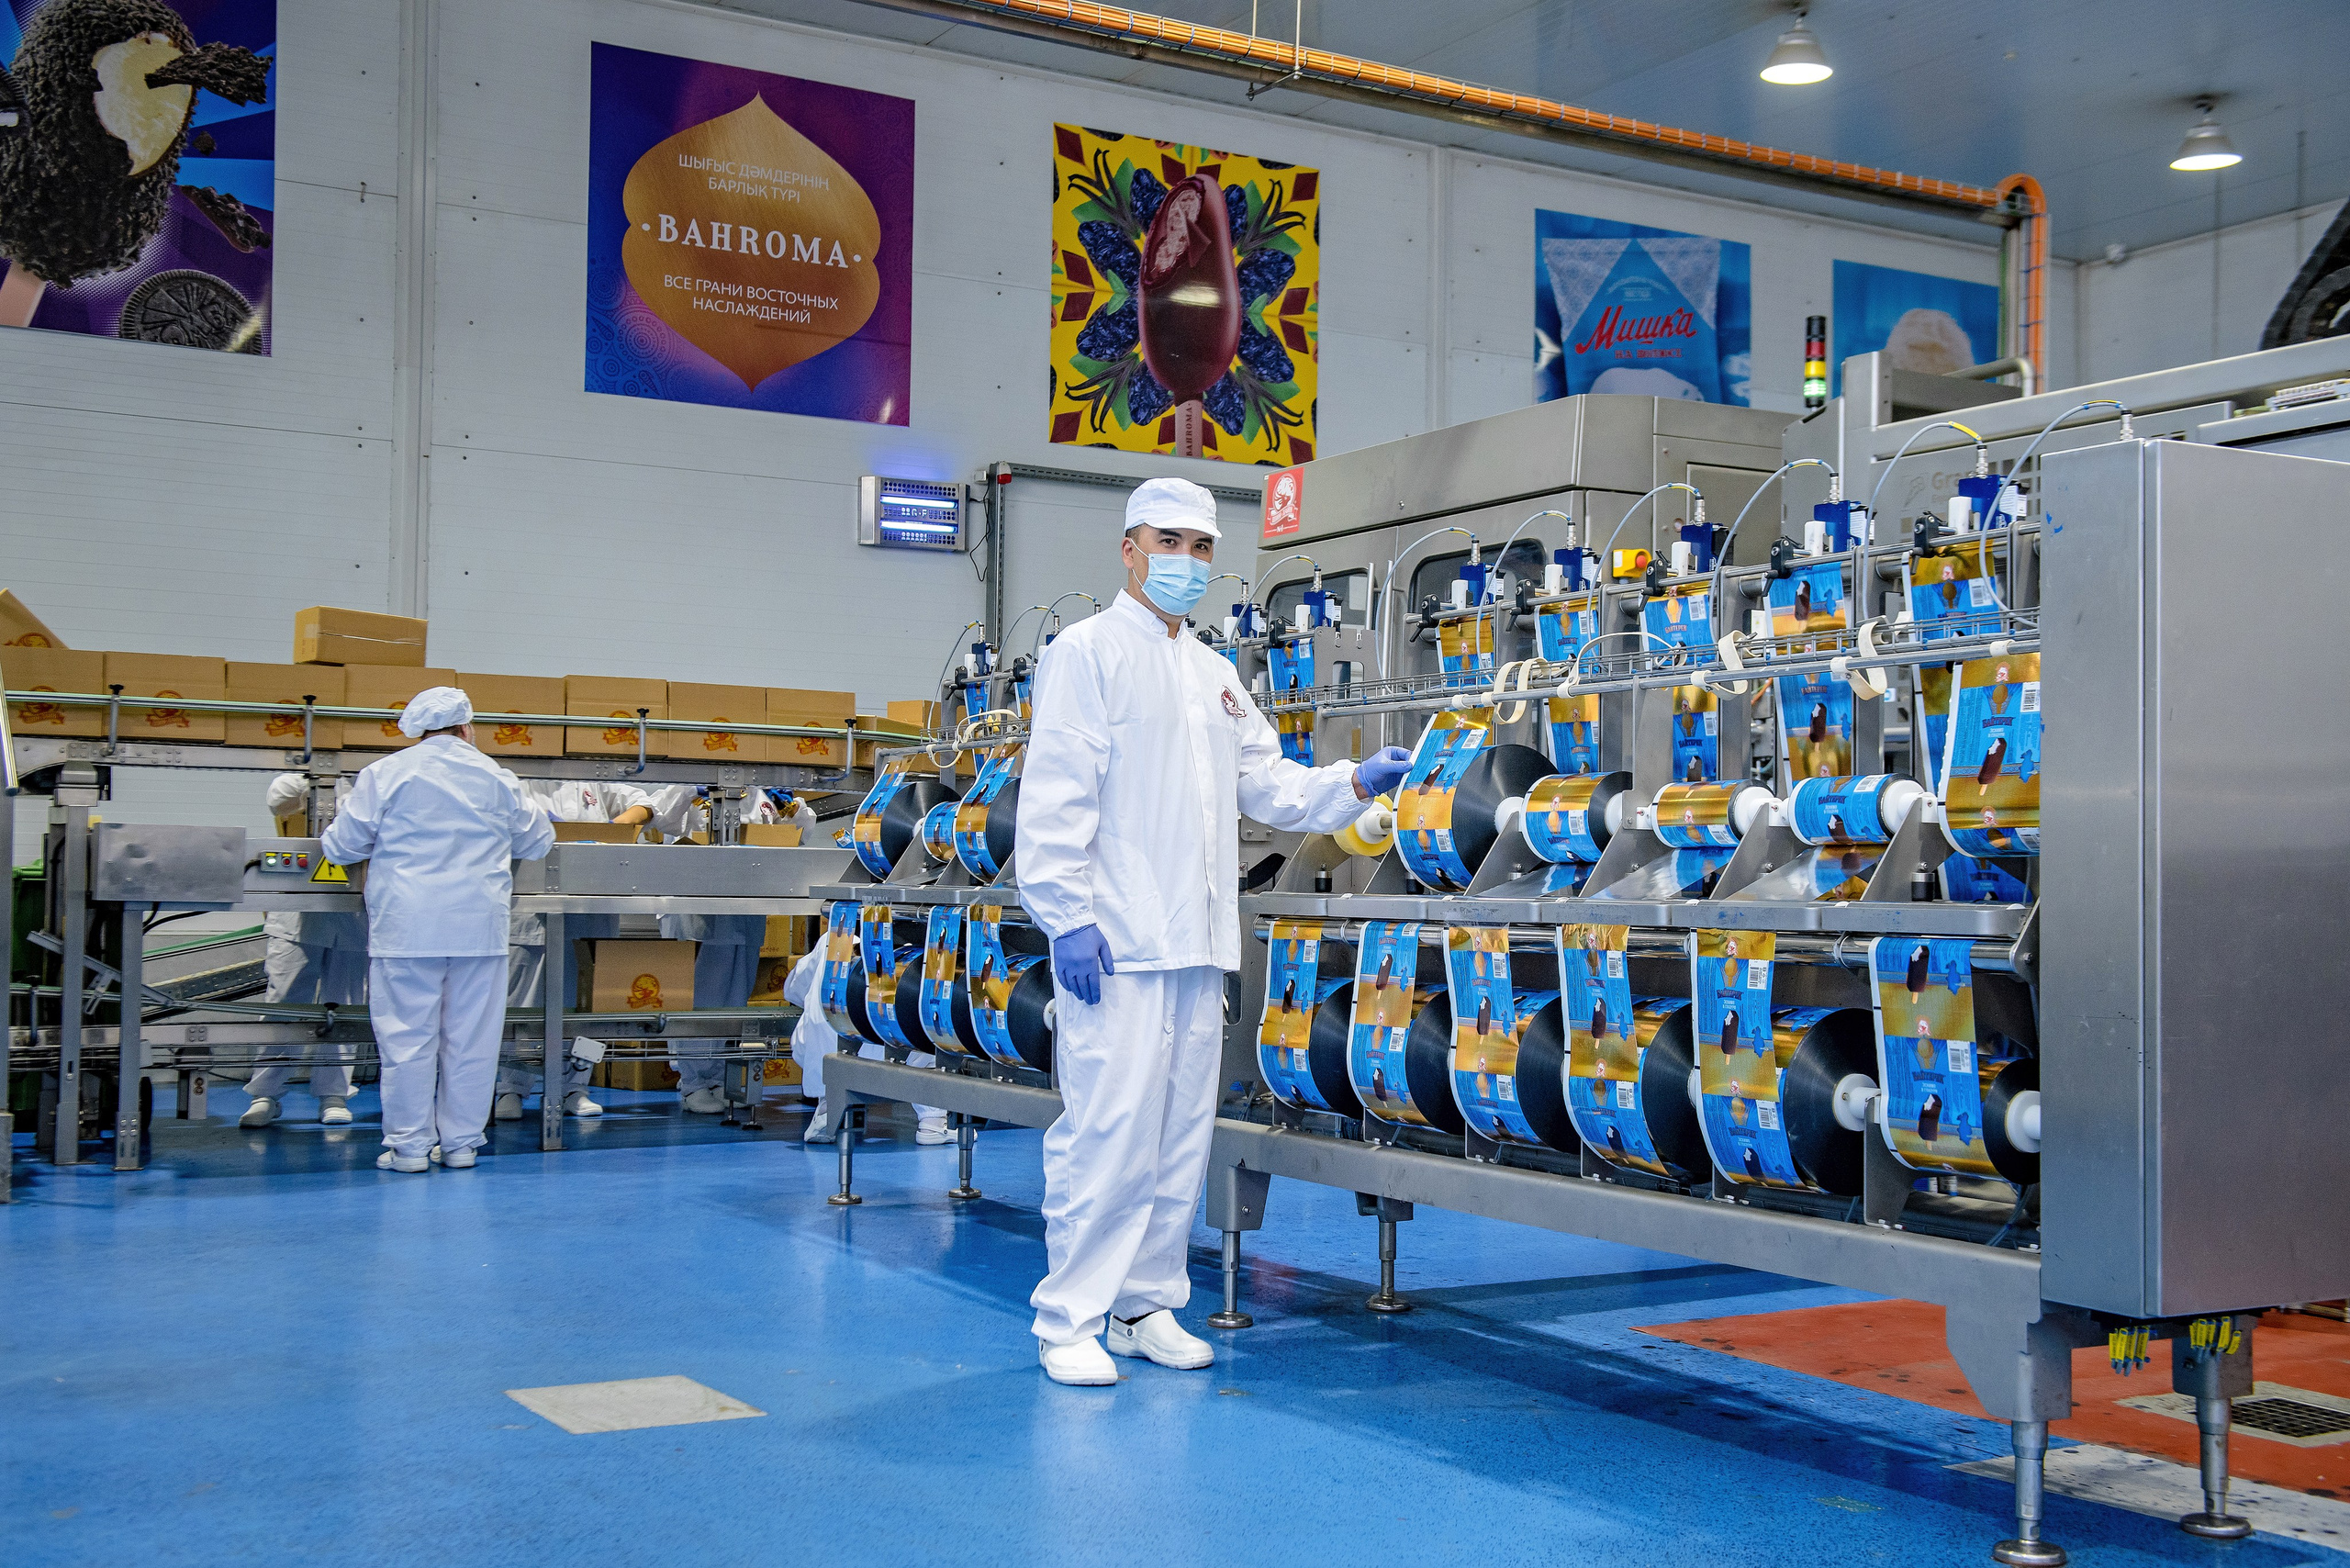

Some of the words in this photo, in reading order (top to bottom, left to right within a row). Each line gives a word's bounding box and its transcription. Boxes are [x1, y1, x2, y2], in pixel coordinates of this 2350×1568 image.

[678, 153, 735, 175] ШЫҒЫС
[739, 163, 829, 191] ДӘМДЕРІНІҢ
[708, 177, 768, 199] БАРЛЫҚ
[771, 186, 800, 203] ТҮРІ
[664, 274, 692, 291] ВСЕ
[695, 279, 743, 297] ГРАНИ
[746, 286, 839, 310] ВОСТОЧНЫХ
[693, 297, 811, 324] НАСЛАЖДЕНИЙ
[1575, 305, 1697, 354] Мишка
